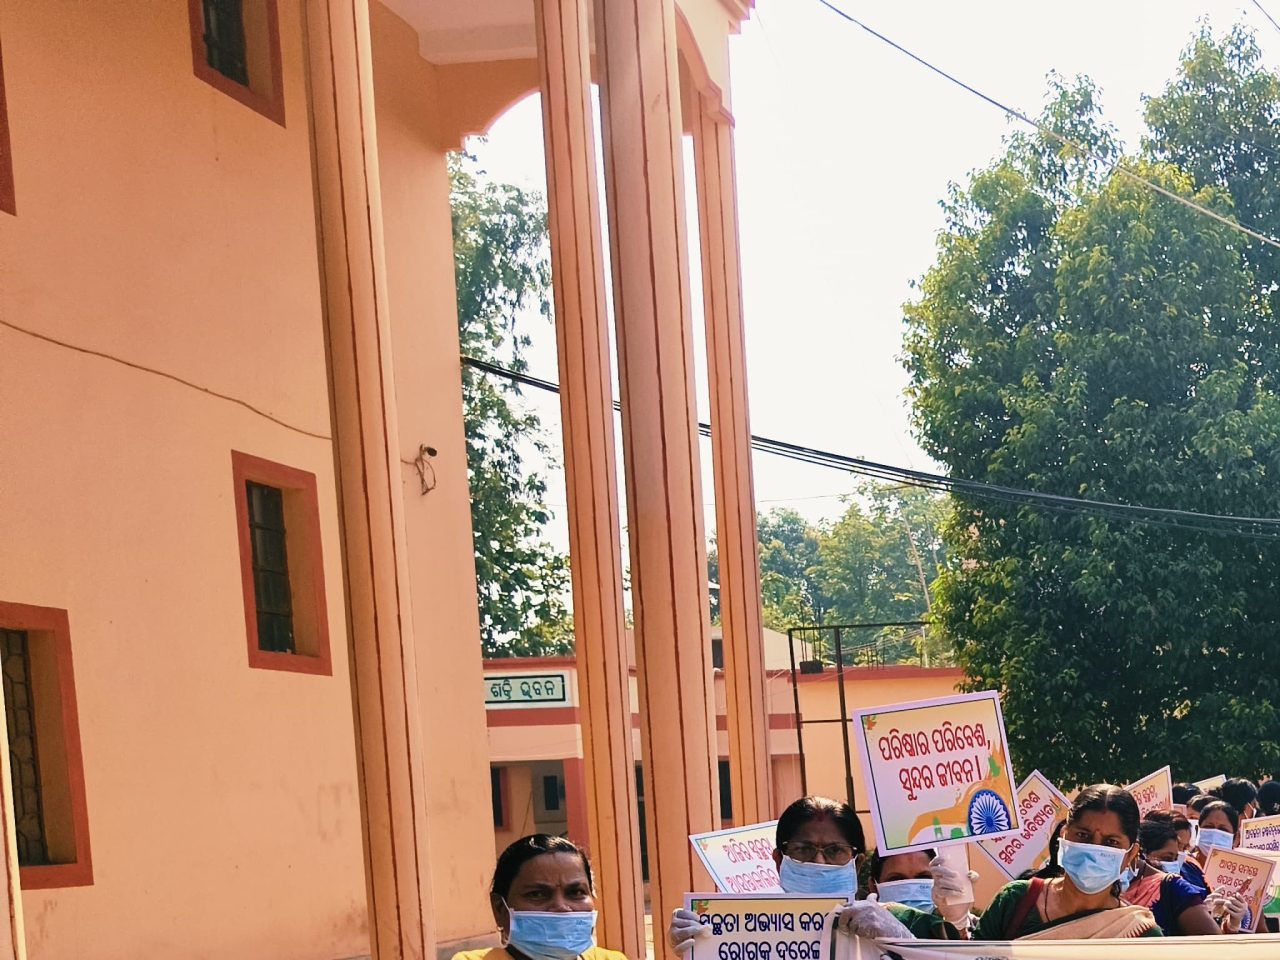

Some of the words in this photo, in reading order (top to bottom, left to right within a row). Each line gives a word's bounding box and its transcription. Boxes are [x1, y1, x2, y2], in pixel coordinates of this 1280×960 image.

[520, 680, 555, 699] ଭବନ
[932, 721, 991, 753] ପରିବେଶ,
[899, 765, 935, 801] ସୁନ୍ଦର
